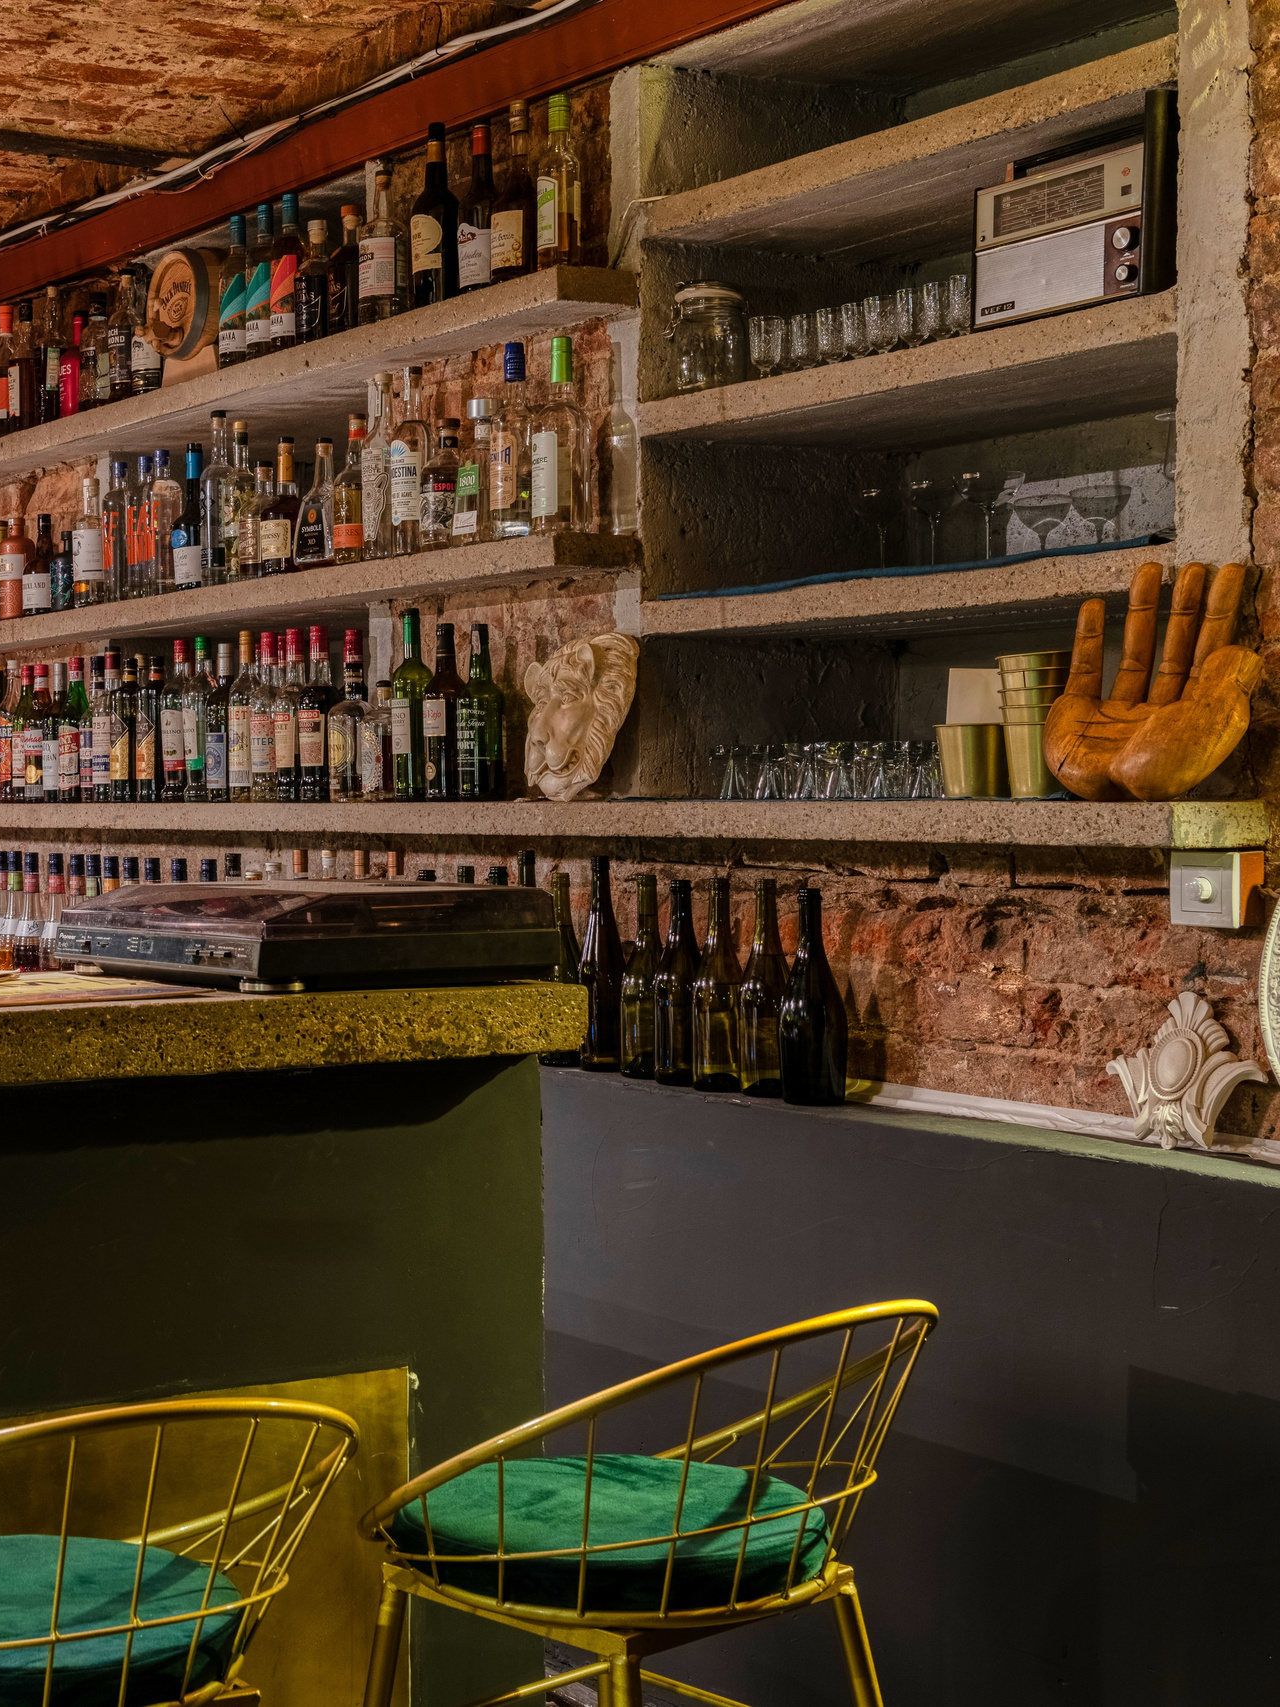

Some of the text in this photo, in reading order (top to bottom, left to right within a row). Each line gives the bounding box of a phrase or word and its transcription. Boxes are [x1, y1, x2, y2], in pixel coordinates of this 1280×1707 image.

[984, 303, 1013, 315] VEF 12
[459, 474, 476, 487] 1800
[301, 523, 322, 533] SYMBOLE
[307, 538, 316, 546] XO
[457, 740, 475, 750] PORT
[59, 932, 77, 940] Pioneer
